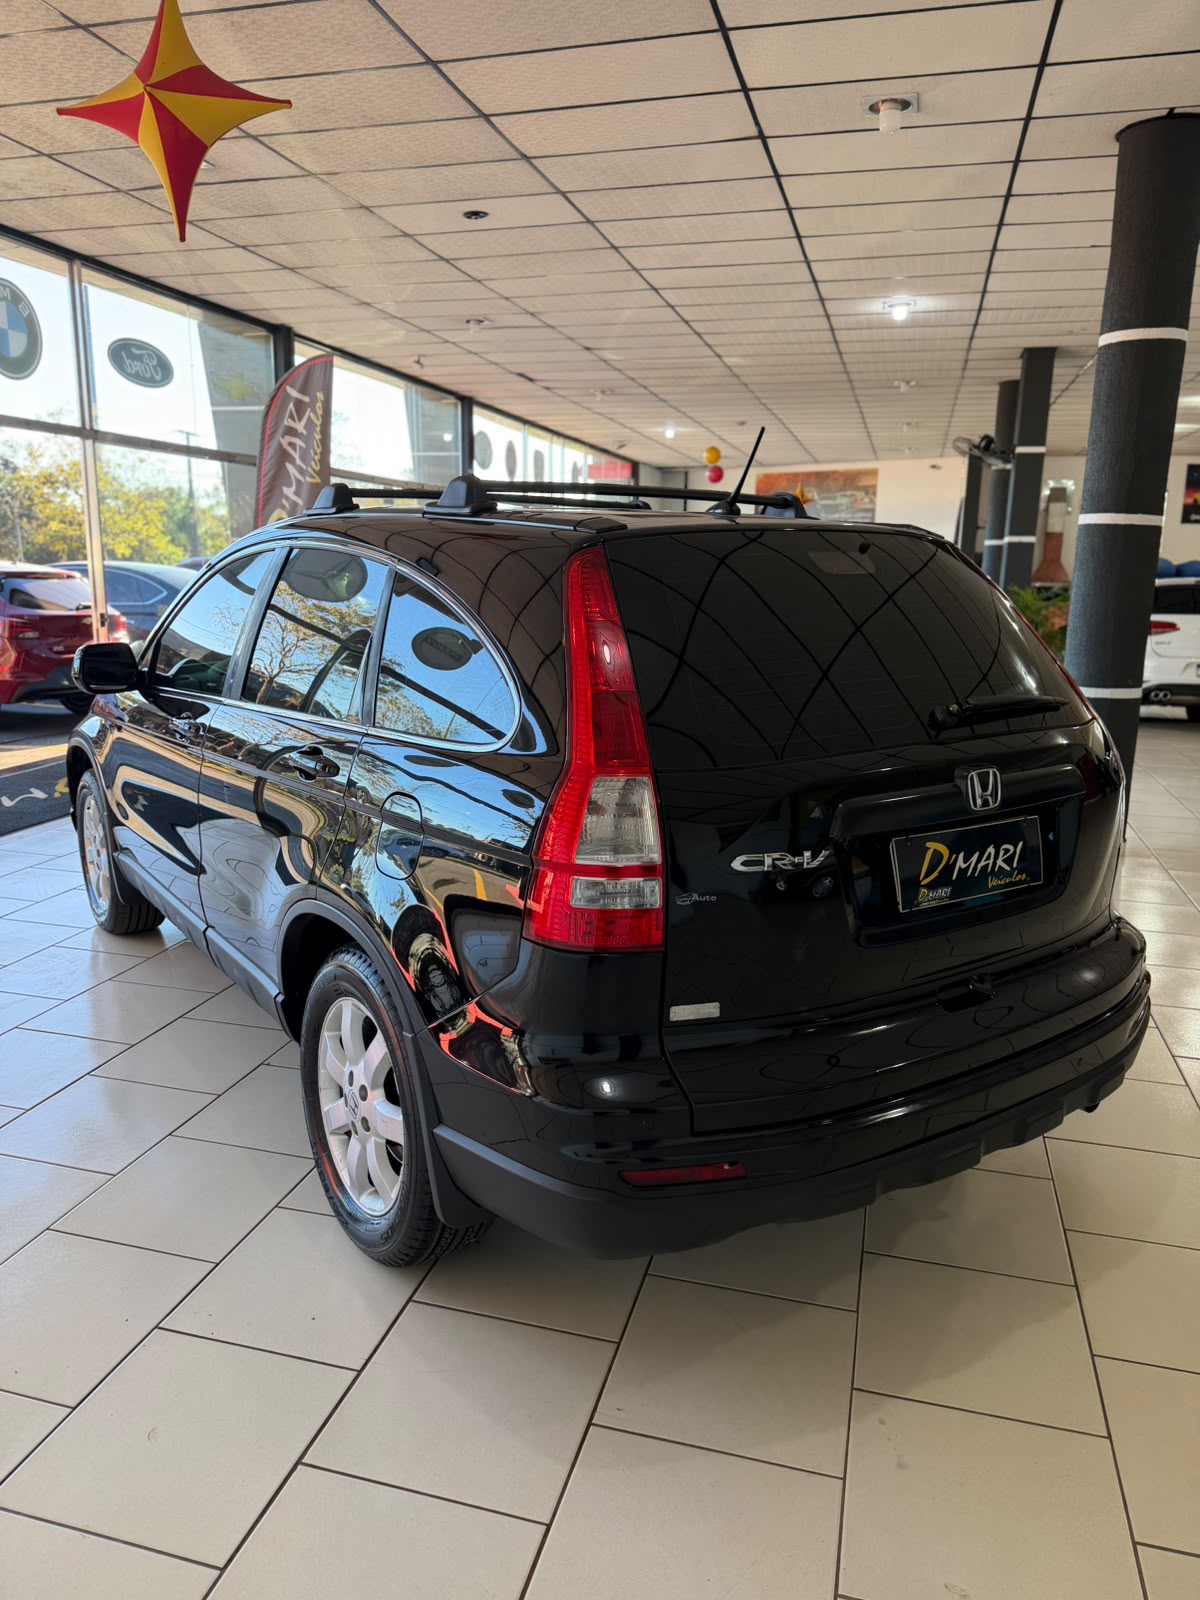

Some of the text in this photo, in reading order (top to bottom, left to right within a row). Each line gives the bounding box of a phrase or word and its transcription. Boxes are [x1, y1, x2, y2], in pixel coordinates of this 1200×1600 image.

[731, 850, 832, 872] CR-V
[920, 841, 1023, 885] D'MARI
[692, 892, 717, 902] Auto
